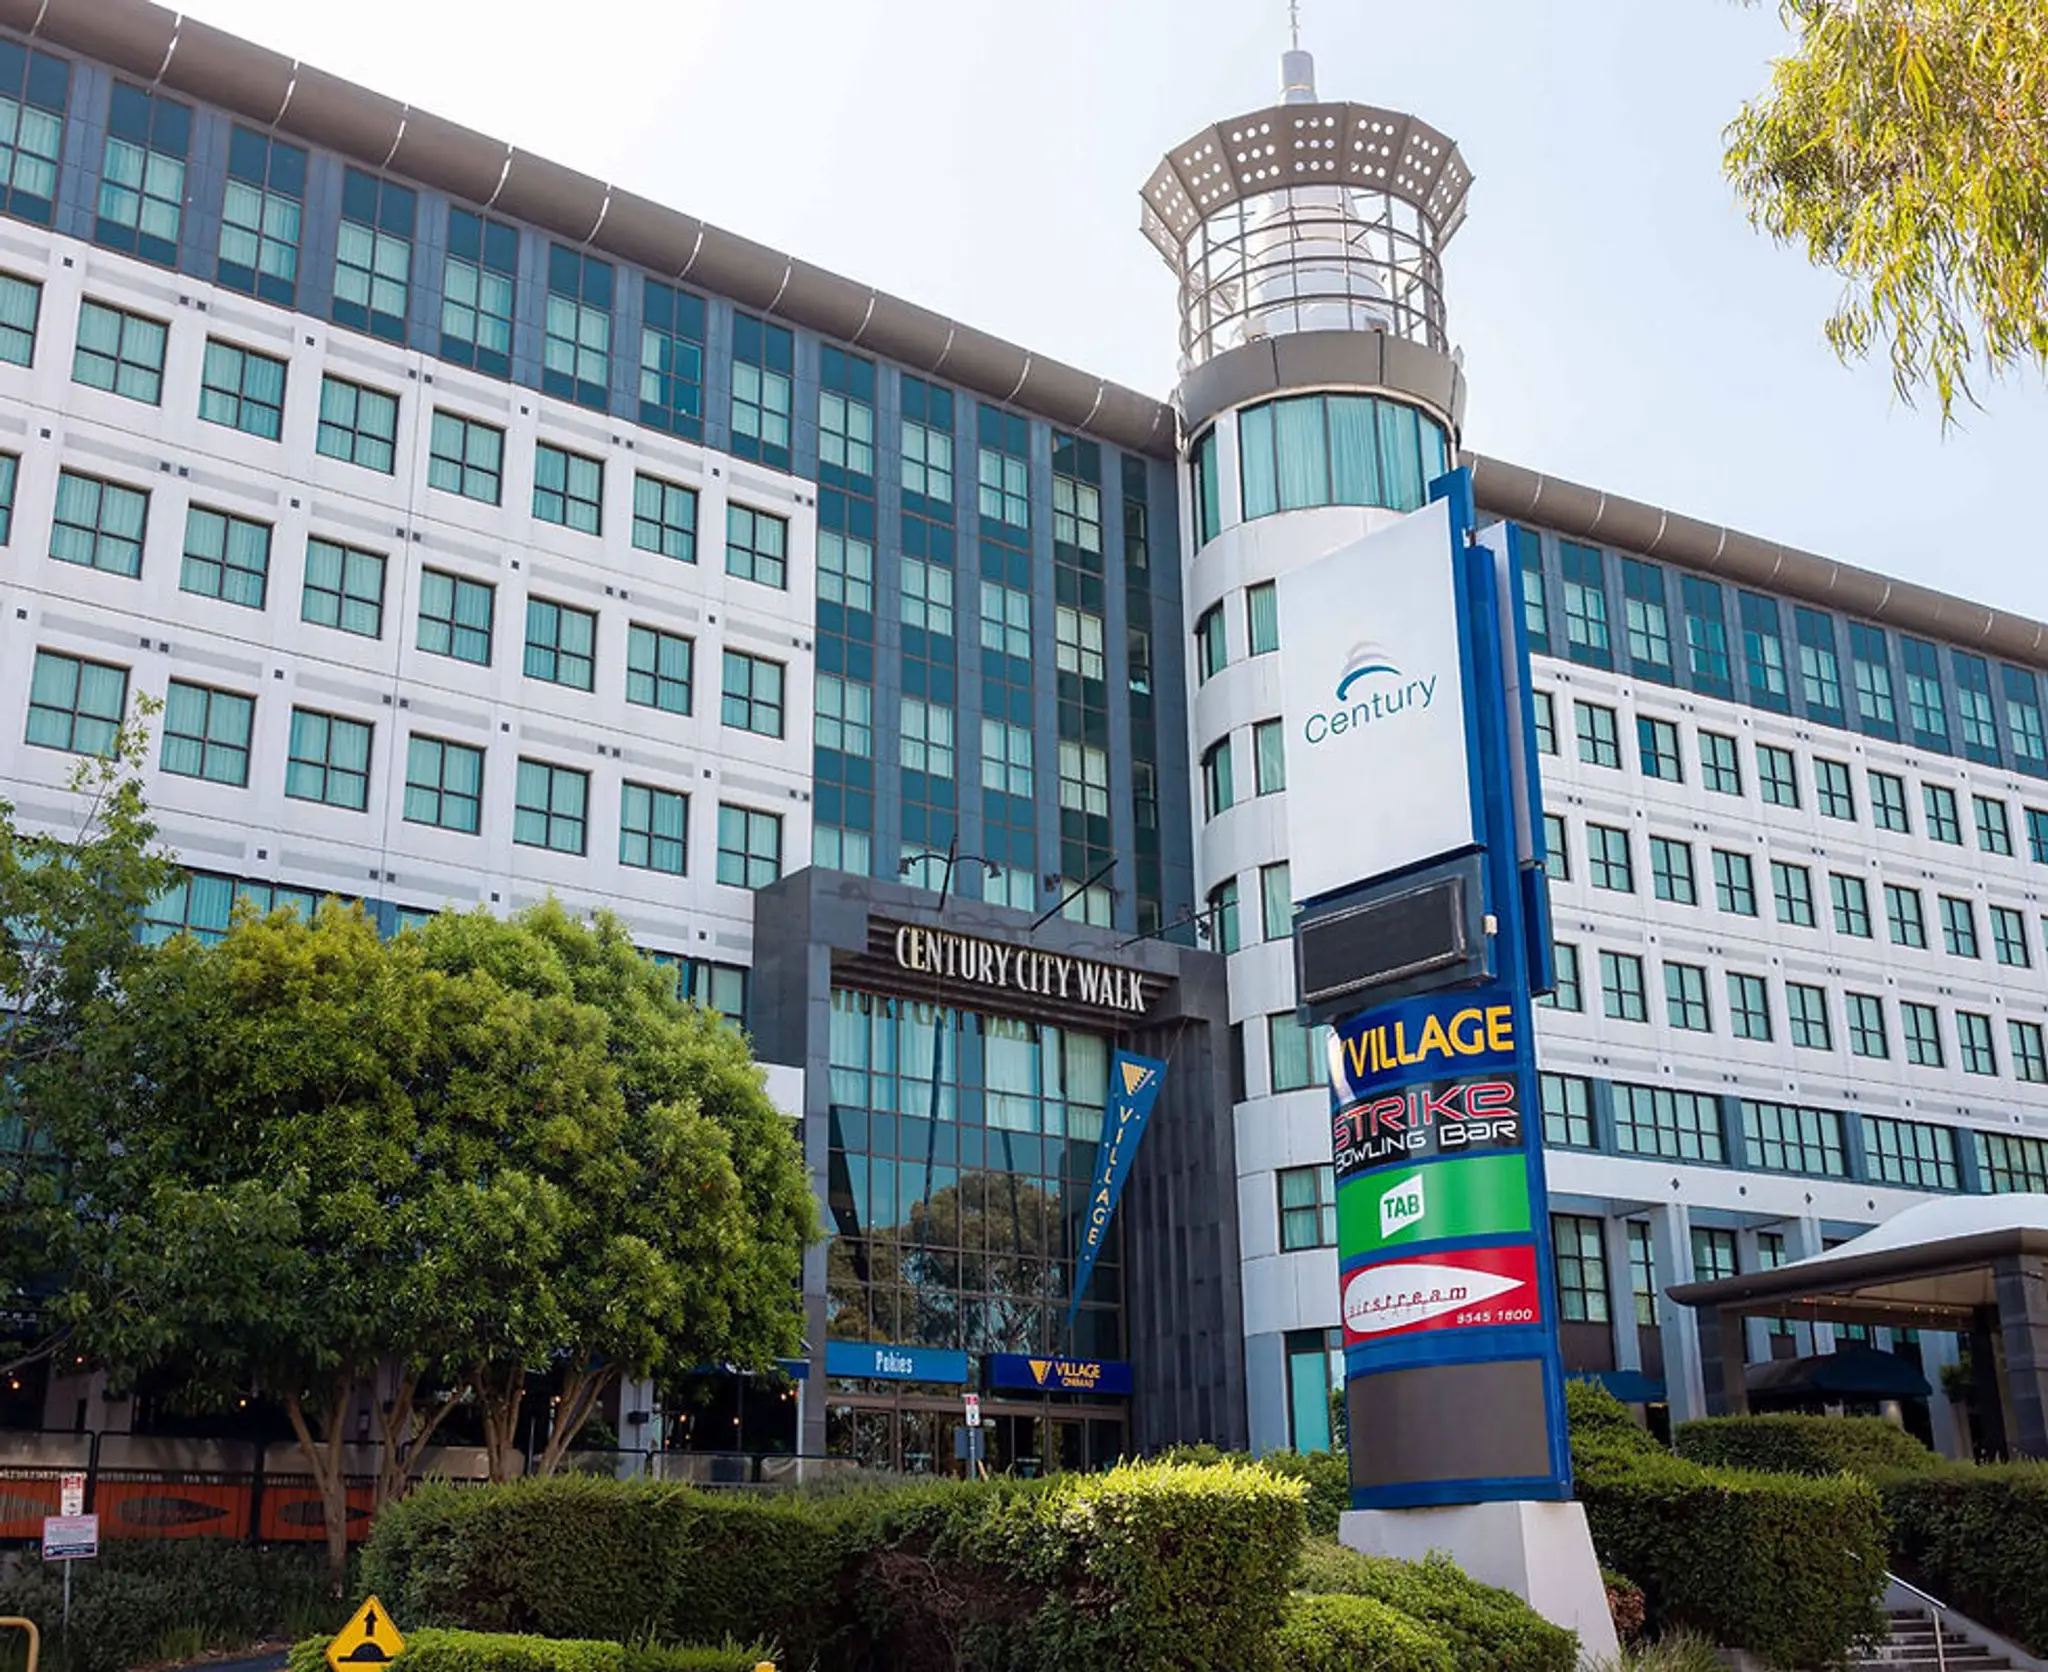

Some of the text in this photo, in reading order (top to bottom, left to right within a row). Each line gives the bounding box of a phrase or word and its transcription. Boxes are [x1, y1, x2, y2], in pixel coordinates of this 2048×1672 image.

[1305, 674, 1437, 744] Century
[896, 926, 1147, 1013] CENTURY CITY WALK
[1348, 1005, 1514, 1078] VILLAGE
[1087, 1105, 1135, 1246] VILLAGE
[1335, 1129, 1427, 1175] BOWLING
[1383, 1194, 1421, 1219] TAB
[875, 1350, 913, 1374] Pokies
[1055, 1361, 1101, 1379] VILLAGE
